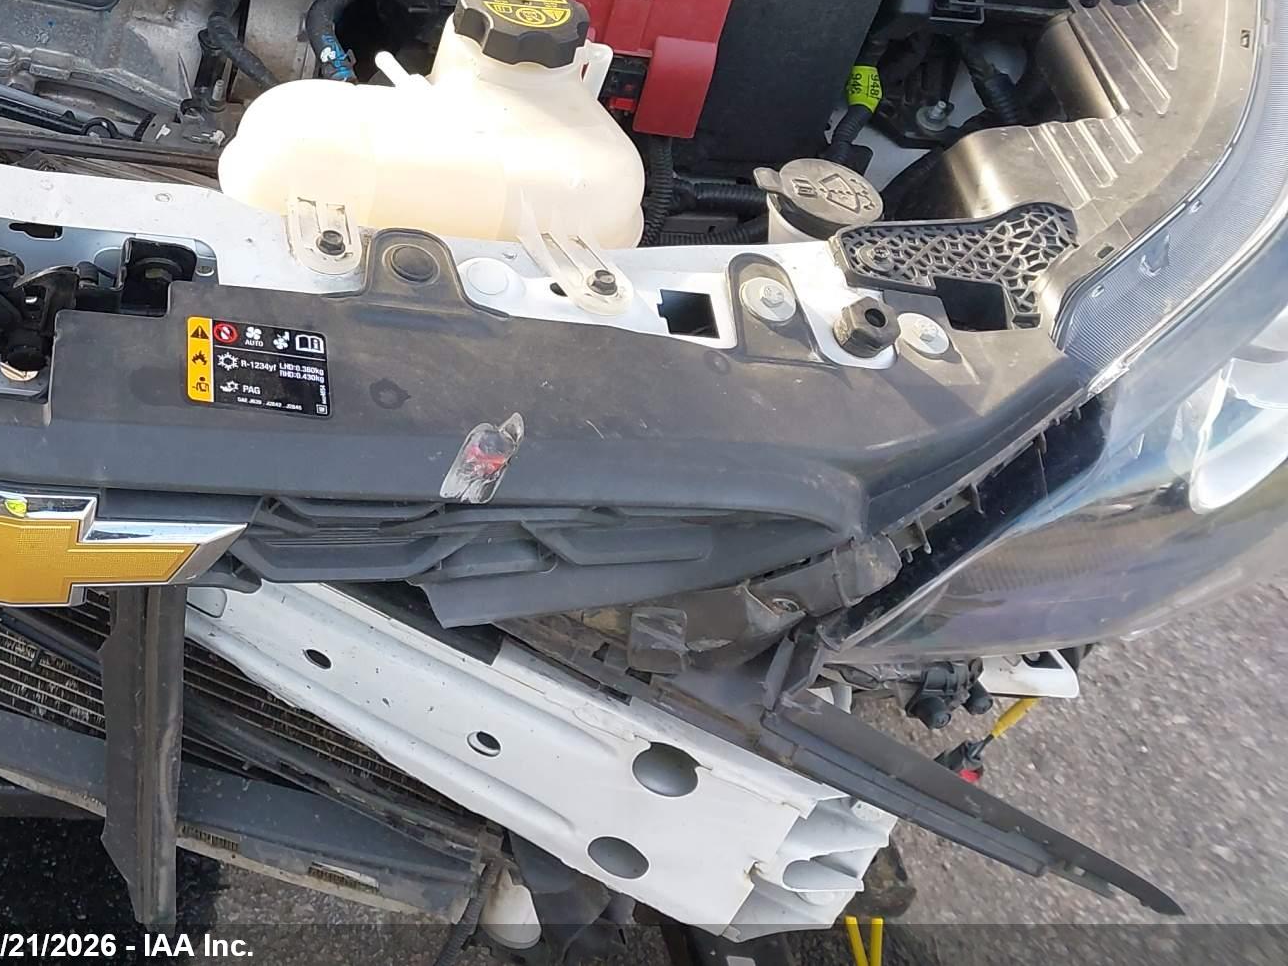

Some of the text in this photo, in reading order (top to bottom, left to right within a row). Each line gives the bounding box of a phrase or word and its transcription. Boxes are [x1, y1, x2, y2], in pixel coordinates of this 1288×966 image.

[244, 339, 264, 348] AUTO
[240, 359, 277, 372] R-1234yf
[242, 384, 261, 395] PAG
